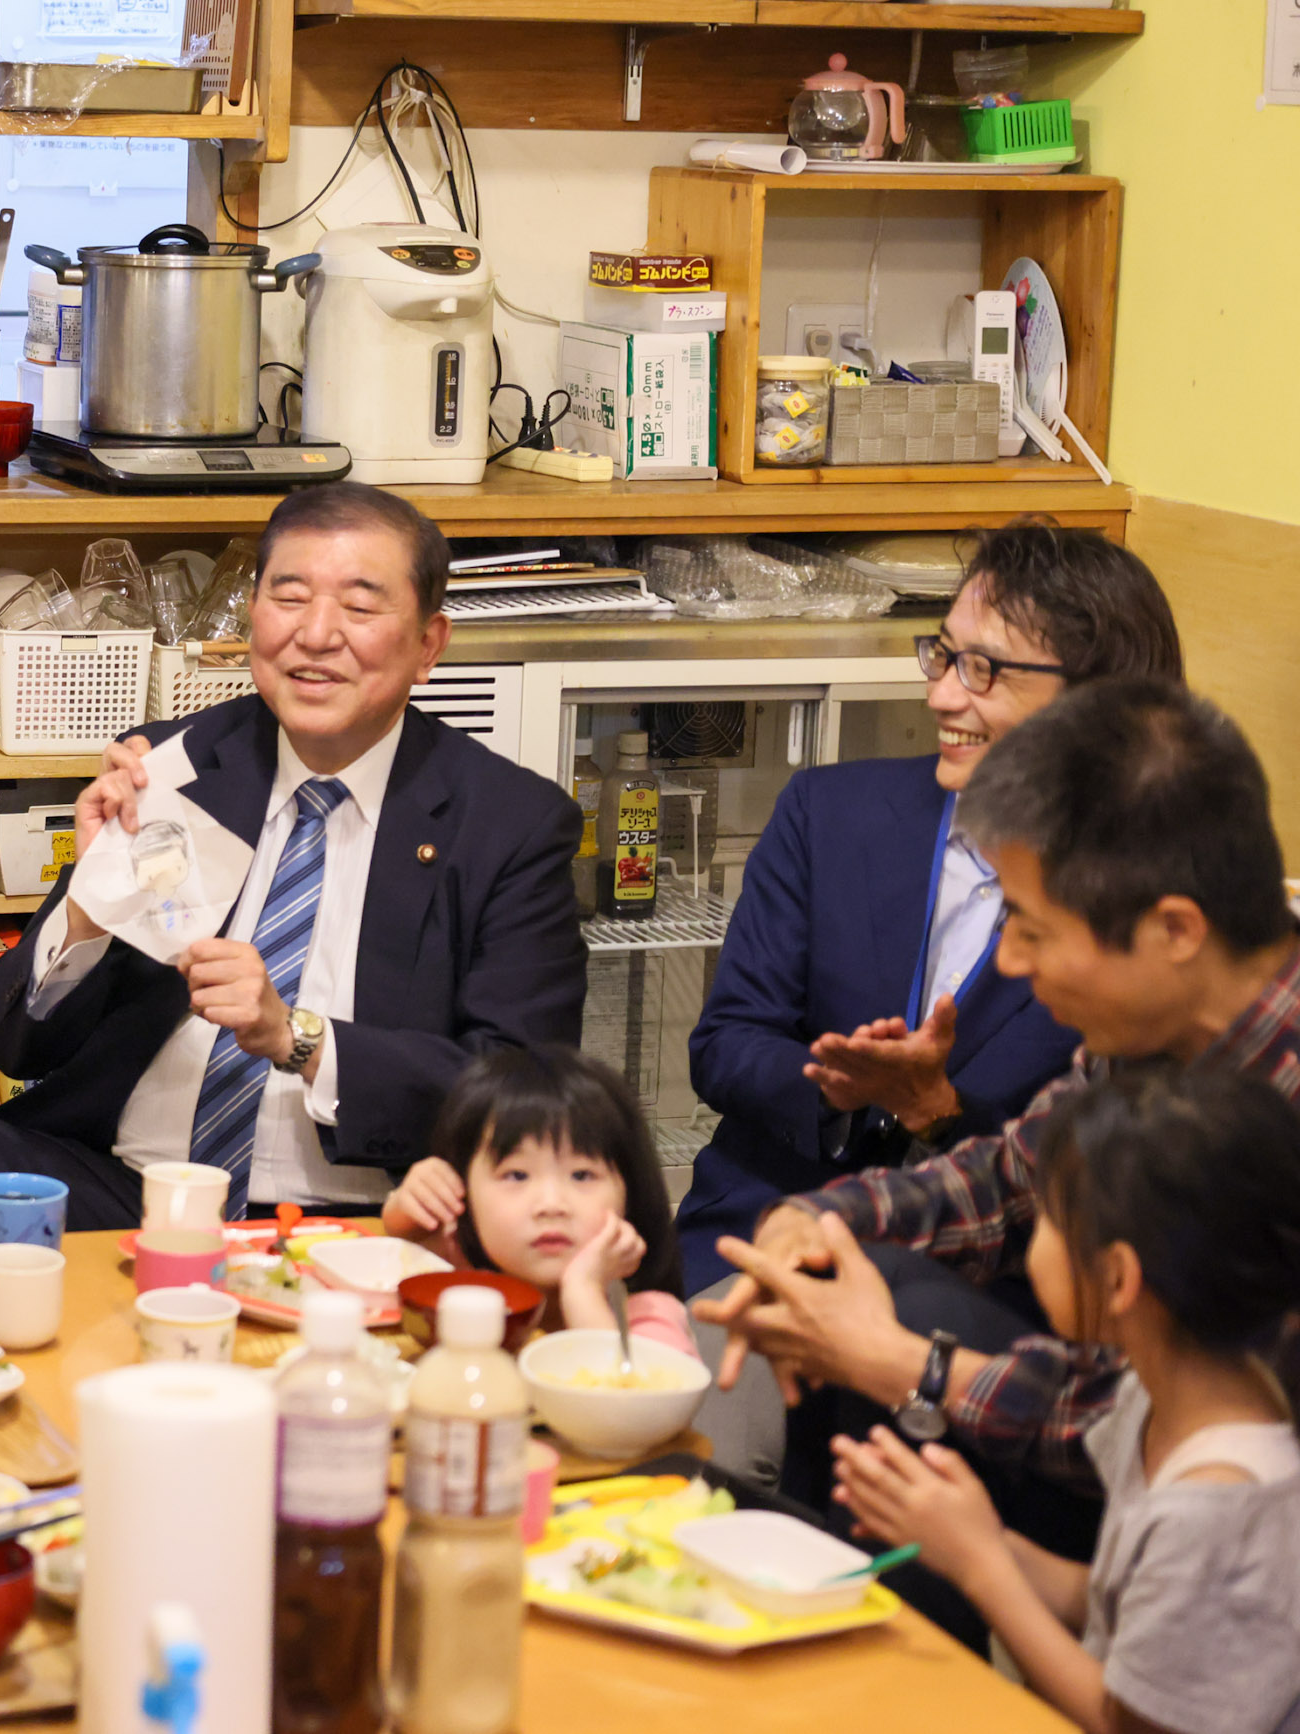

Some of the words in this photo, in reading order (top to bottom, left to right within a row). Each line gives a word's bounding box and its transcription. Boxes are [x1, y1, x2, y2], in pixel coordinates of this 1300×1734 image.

[591, 262, 623, 281] ゴムバンド
[639, 265, 691, 280] ゴムバンド
[439, 425, 453, 433] 2.2
[620, 807, 657, 818] デリシャス
[627, 818, 651, 829] ソース
[618, 831, 657, 845] ウスター
